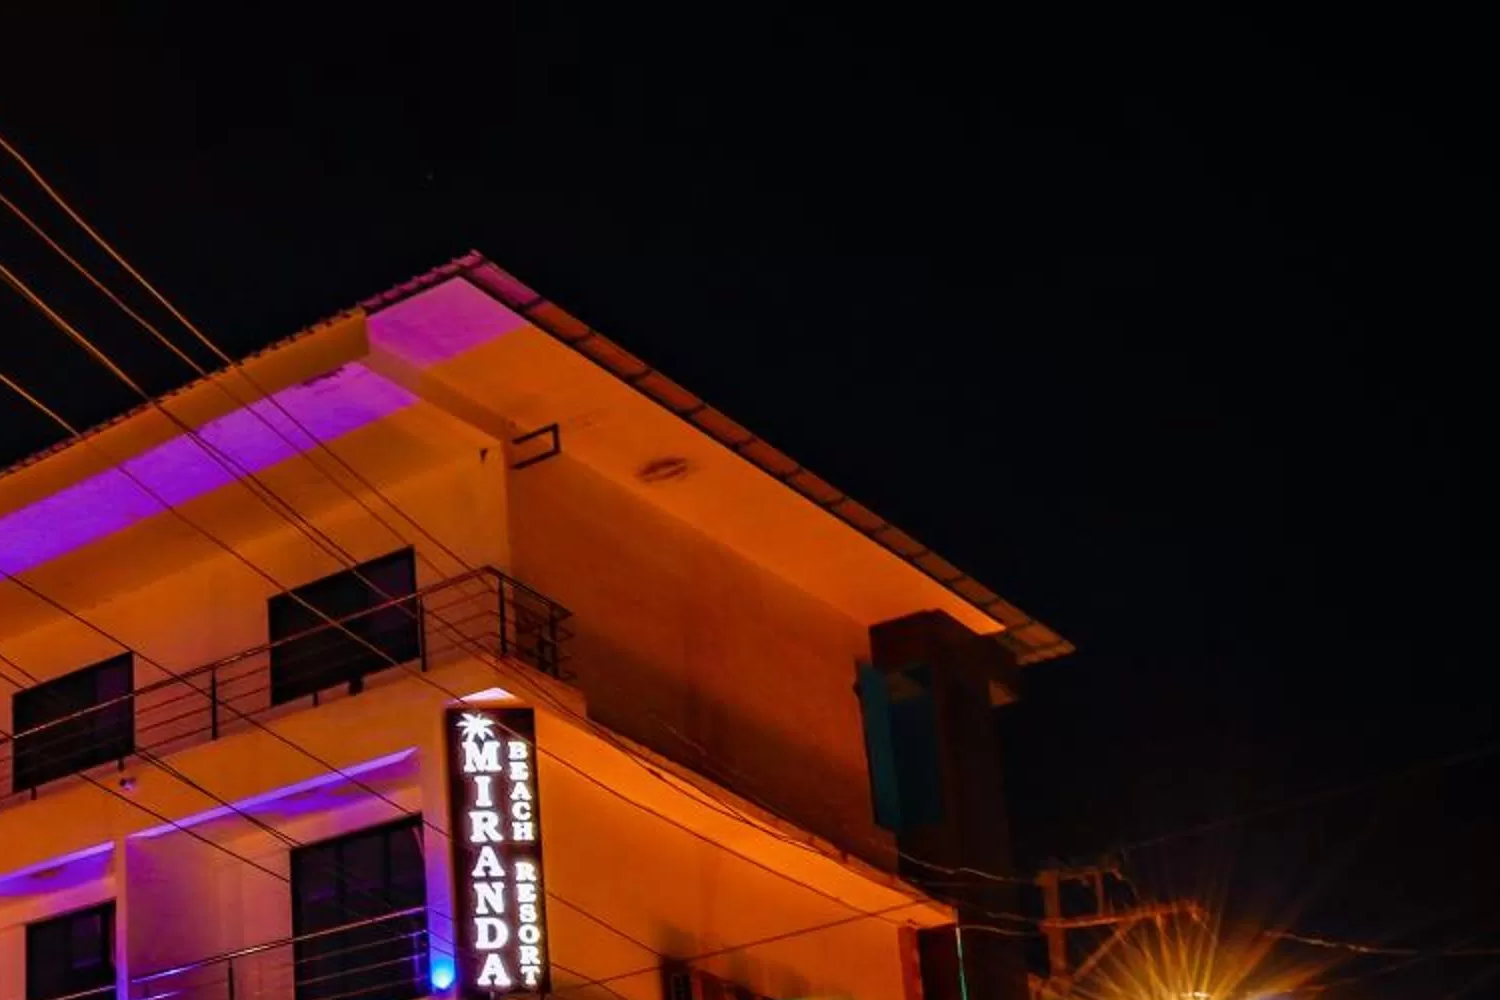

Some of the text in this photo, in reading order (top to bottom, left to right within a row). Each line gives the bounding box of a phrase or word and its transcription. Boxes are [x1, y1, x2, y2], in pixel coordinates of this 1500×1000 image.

[508, 741, 534, 841] BEACH
[461, 741, 511, 987] MIRANDA
[515, 862, 541, 985] RESORT
